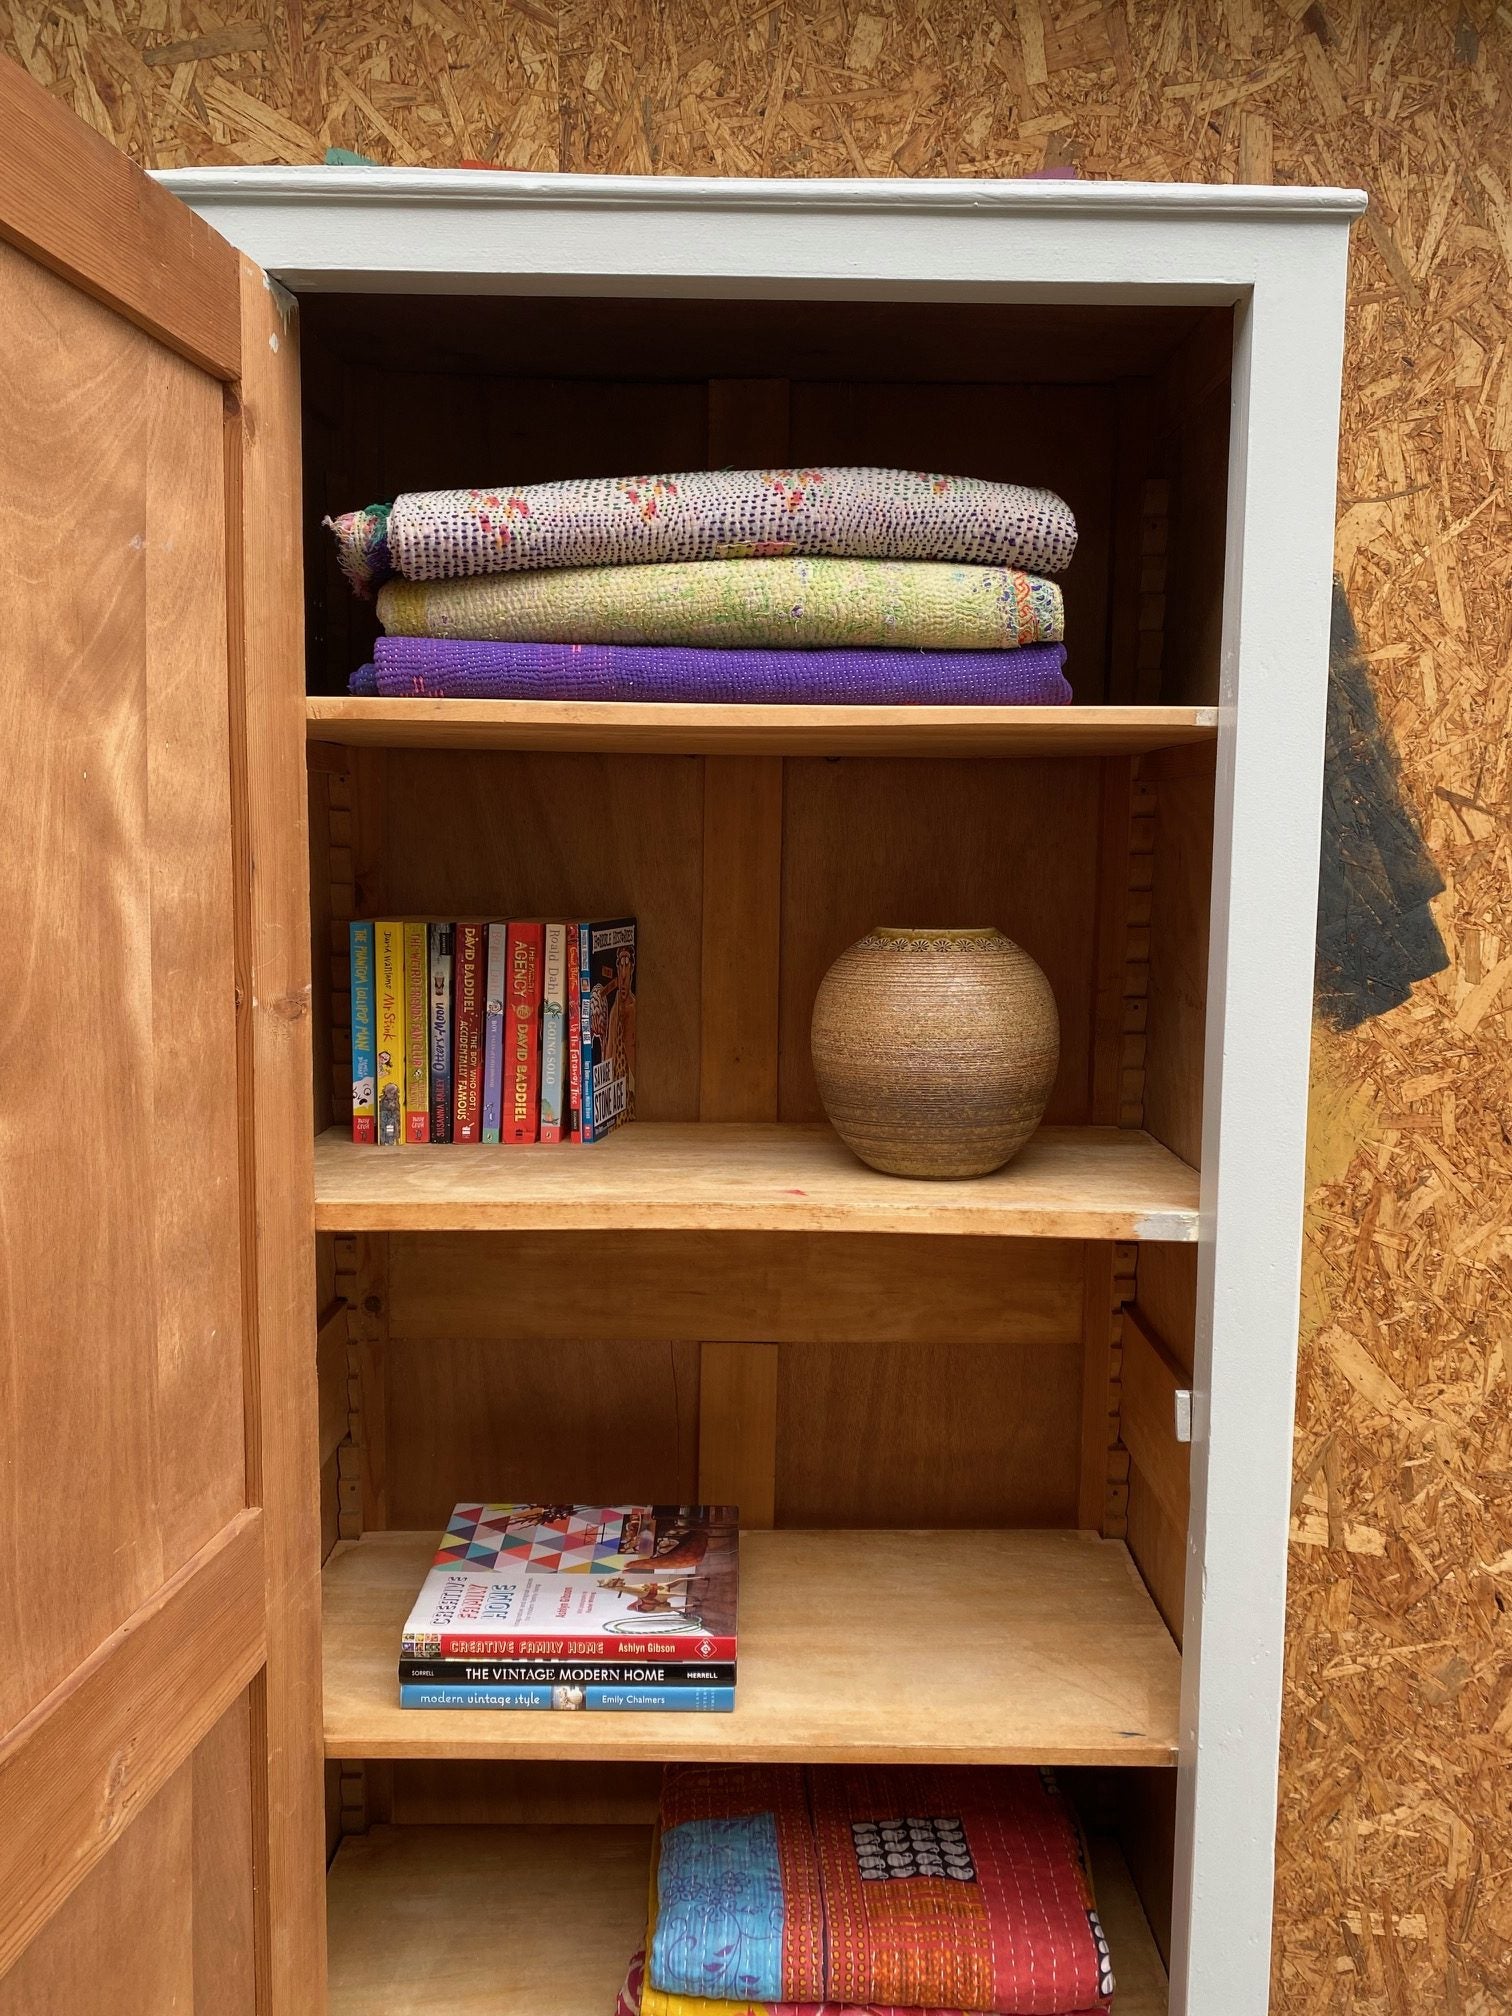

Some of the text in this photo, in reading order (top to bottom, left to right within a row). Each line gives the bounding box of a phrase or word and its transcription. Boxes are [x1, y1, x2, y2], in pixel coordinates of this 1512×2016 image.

[354, 929, 367, 942] THE
[355, 945, 368, 983] PHANTOM
[384, 931, 393, 989] David Walliams
[463, 928, 475, 1013] DAVID BADDIEL
[513, 940, 528, 998] AGENCY
[548, 929, 560, 995] Roald Dahl
[383, 993, 396, 1042] Mr Stink
[434, 1002, 447, 1035] Moon
[412, 1043, 424, 1068] CLUB
[457, 1020, 469, 1120] ACCIDENTALLY FAMOUS
[469, 1051, 477, 1067] BOY
[546, 1021, 557, 1085] GOING SOLO
[570, 1049, 580, 1085] Faraway
[469, 1069, 477, 1088] WHO
[515, 1024, 528, 1122] DAVID BADDIEL
[594, 1061, 611, 1088] SAVAGE
[469, 1090, 477, 1111] GOT)
[571, 1086, 580, 1105] Tree
[594, 1086, 612, 1124] STONE
[613, 1081, 624, 1109] AGE
[436, 1104, 445, 1137] SUSANNA
[430, 1576, 468, 1626] CREATIVE
[457, 1583, 489, 1620] FAMILY
[481, 1584, 517, 1620] HOME
[450, 1641, 604, 1654] CREATIVE FAMILY HOME
[618, 1643, 676, 1655] Ashlyn Gibson
[465, 1668, 665, 1681] THE VINTAGE MODERN HOME
[420, 1690, 541, 1707] modern vintage style
[602, 1695, 665, 1706] Emily Chalmers
